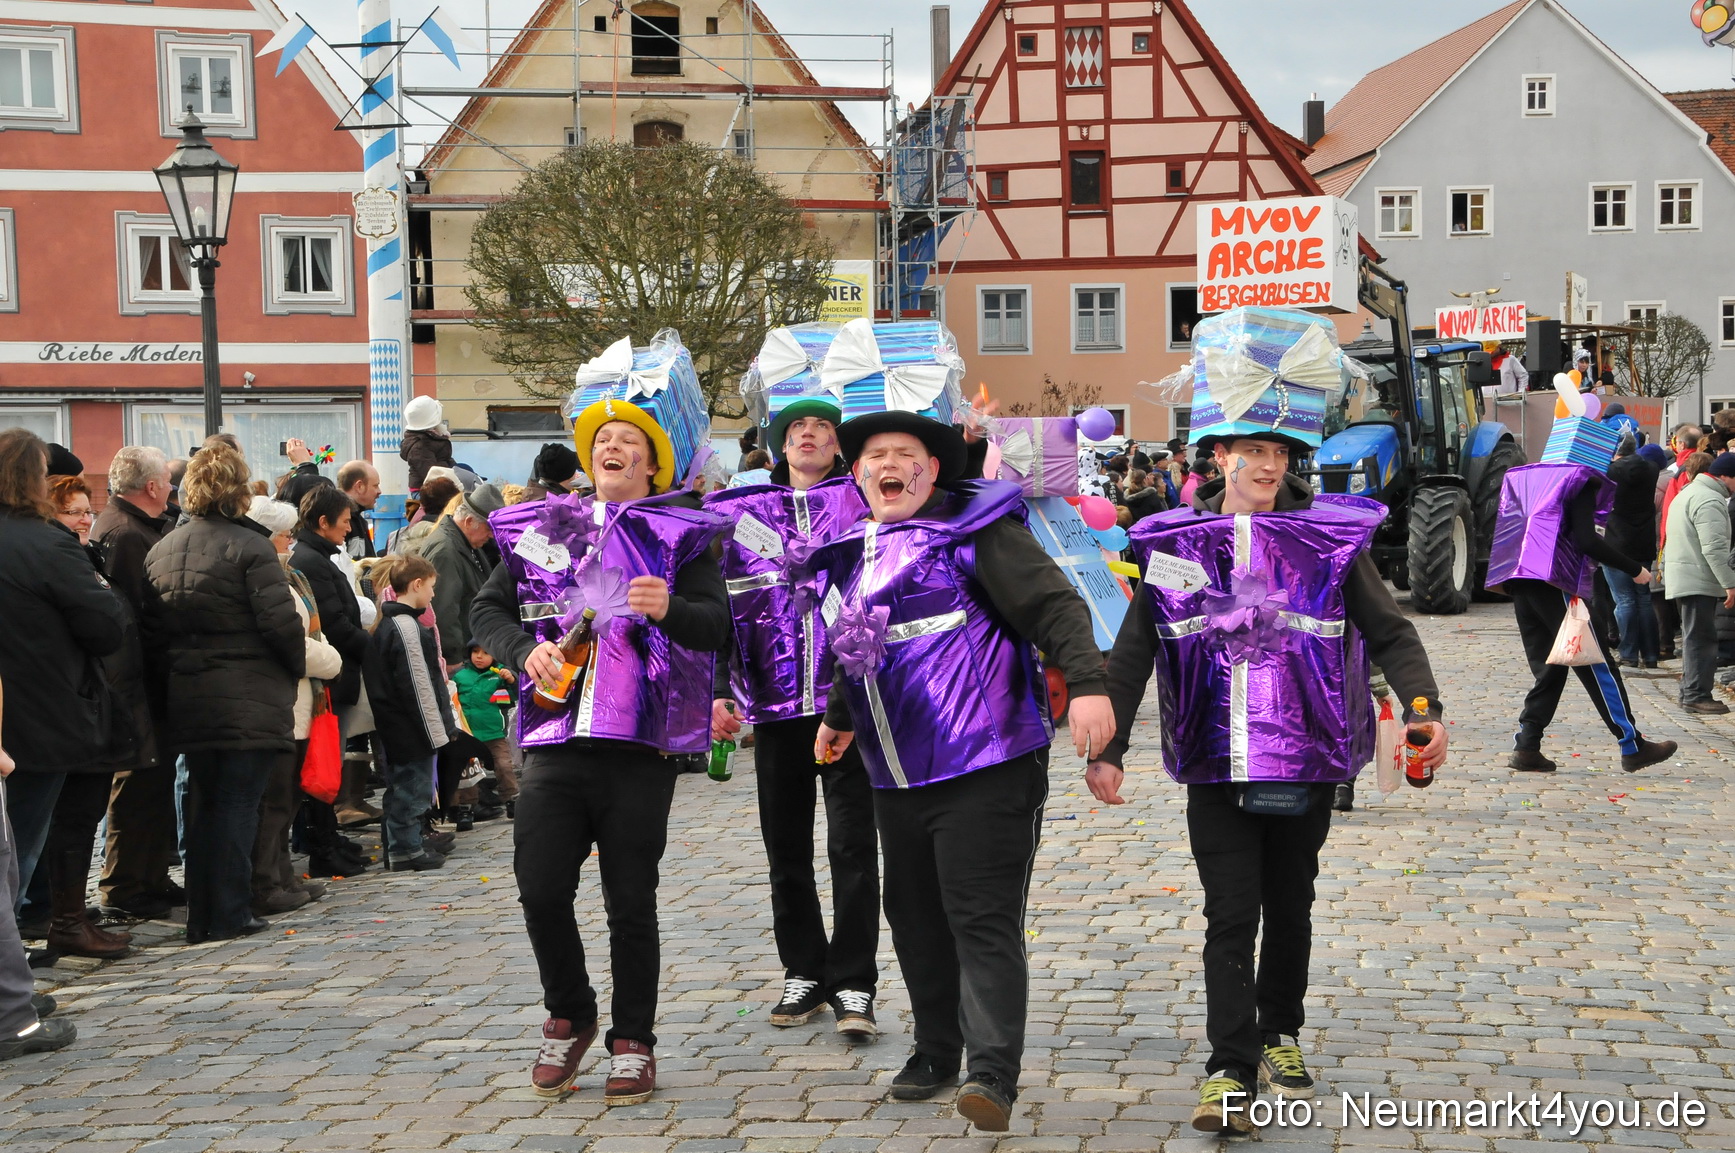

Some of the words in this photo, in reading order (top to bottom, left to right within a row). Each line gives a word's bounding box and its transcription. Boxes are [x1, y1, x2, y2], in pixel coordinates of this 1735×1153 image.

[1211, 205, 1322, 238] MVOV
[1207, 237, 1326, 281] ARCHE
[1201, 281, 1331, 311] BERGHAUSEN
[1482, 304, 1525, 335] ARCHE
[38, 342, 113, 362] Riebe
[120, 344, 204, 362] Moden
[1153, 556, 1169, 566] TAKE
[1169, 560, 1179, 569] ME
[1164, 567, 1190, 578] UNWRAP
[1258, 792, 1297, 801] REISEBÜRO
